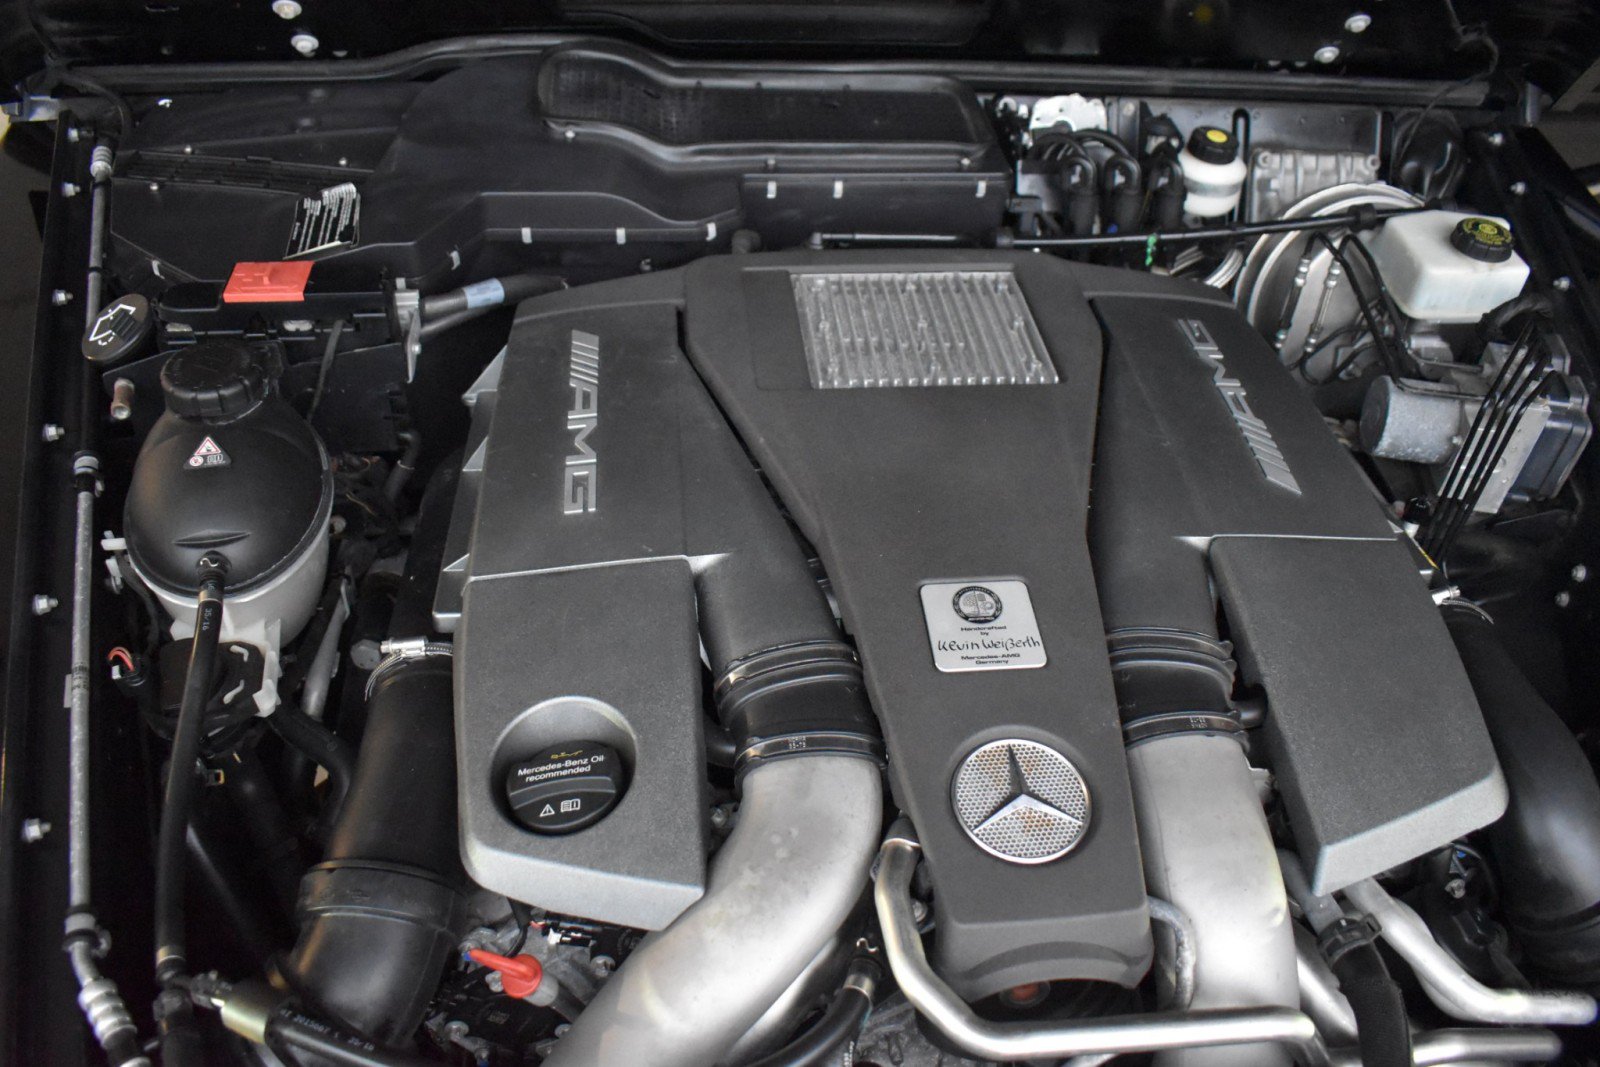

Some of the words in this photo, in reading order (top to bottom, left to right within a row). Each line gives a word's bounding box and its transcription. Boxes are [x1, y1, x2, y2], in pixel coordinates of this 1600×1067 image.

[564, 376, 598, 515] AMG
[518, 758, 589, 776] Mercedes-Benz
[590, 755, 604, 763] Oil
[525, 765, 591, 782] recommended
